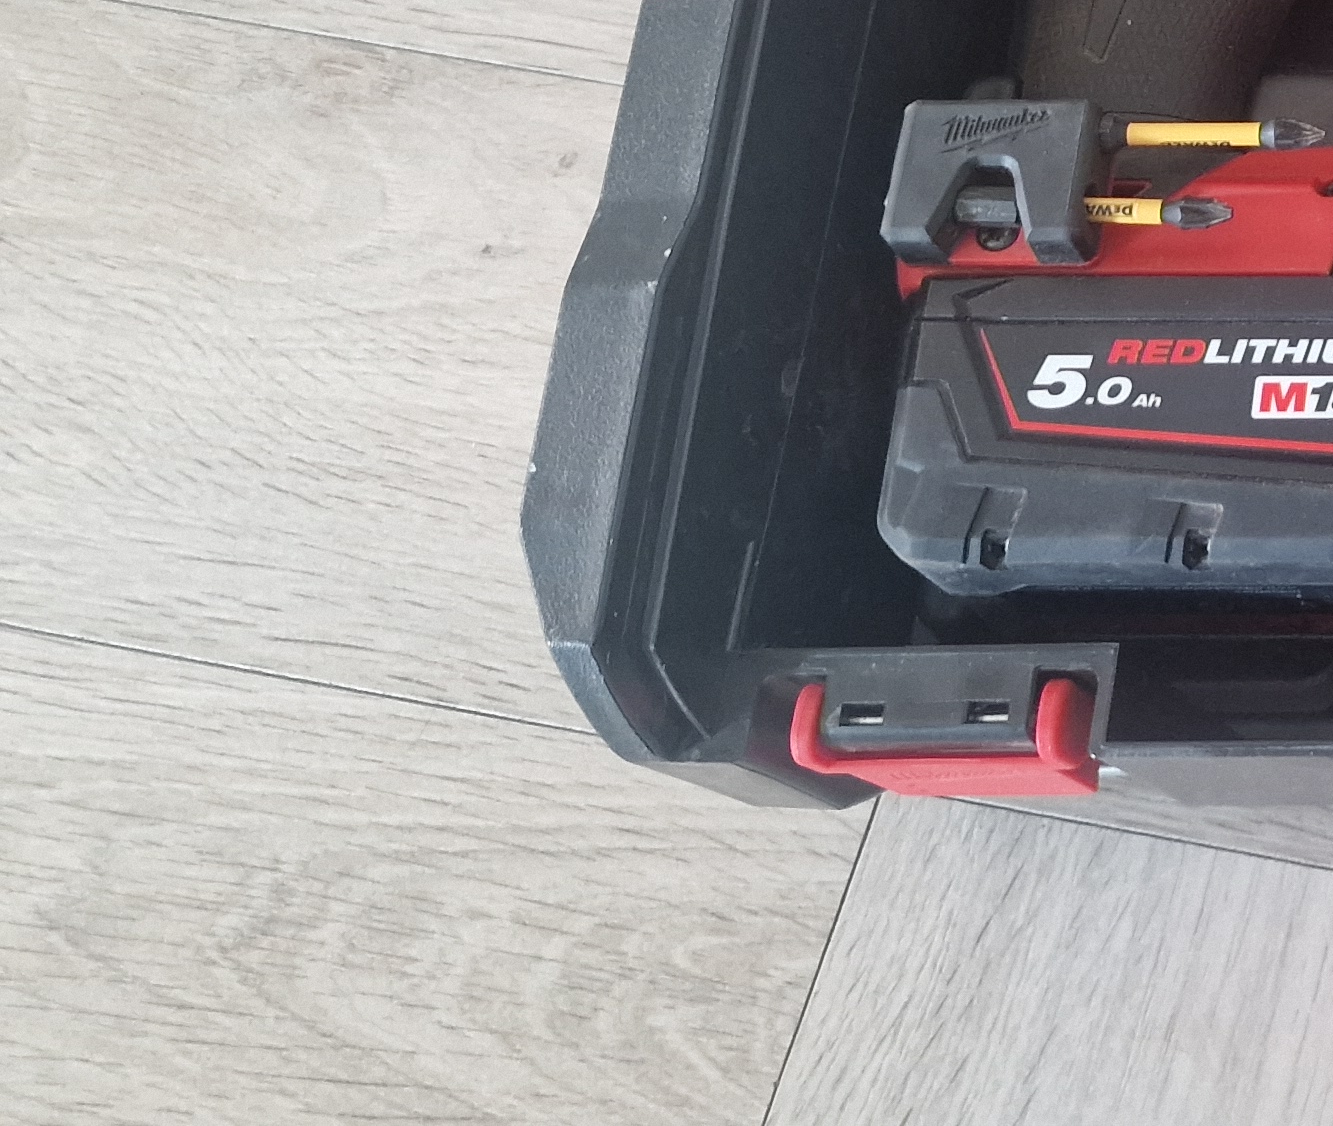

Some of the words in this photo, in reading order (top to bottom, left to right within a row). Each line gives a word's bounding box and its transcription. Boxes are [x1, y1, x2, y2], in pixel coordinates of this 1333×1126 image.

[941, 107, 1050, 144] Milwaukee
[1027, 354, 1133, 409] 5.0
[1132, 393, 1162, 408] Ah
